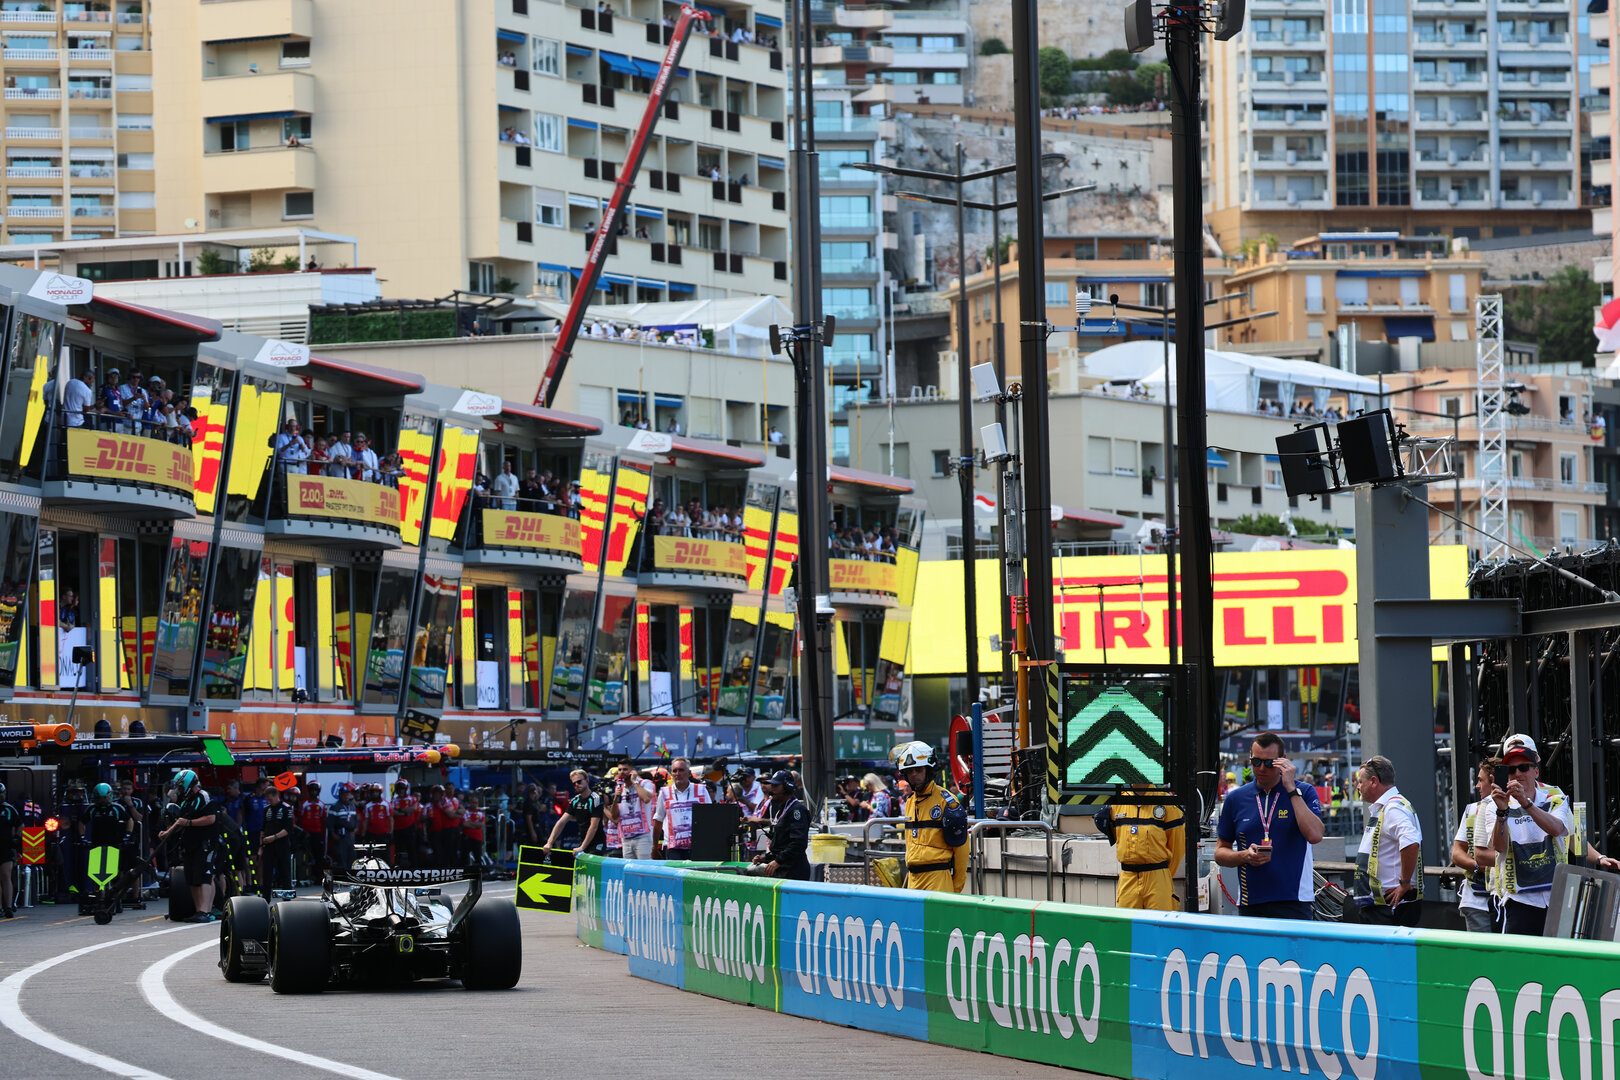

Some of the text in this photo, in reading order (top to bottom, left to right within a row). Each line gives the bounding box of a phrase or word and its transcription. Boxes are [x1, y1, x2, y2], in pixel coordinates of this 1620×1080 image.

[94, 438, 150, 475] DHL
[328, 488, 347, 500] DHL
[503, 515, 546, 543] DHL
[673, 541, 712, 566] DHL
[831, 563, 871, 586] DHL
[71, 742, 111, 750] Einhell
[374, 753, 389, 762] Red
[389, 753, 410, 762] Bull
[912, 829, 917, 837] S
[1131, 826, 1137, 834] S
[1466, 826, 1475, 860] MONAC
[356, 869, 464, 882] CROWDSTRIKE
[1505, 858, 1515, 892] ONACO
[626, 888, 676, 967] aramco
[692, 894, 766, 985] aramco
[795, 910, 905, 1011] aramco
[946, 927, 1101, 1044] aramco
[1160, 948, 1380, 1080] aramco
